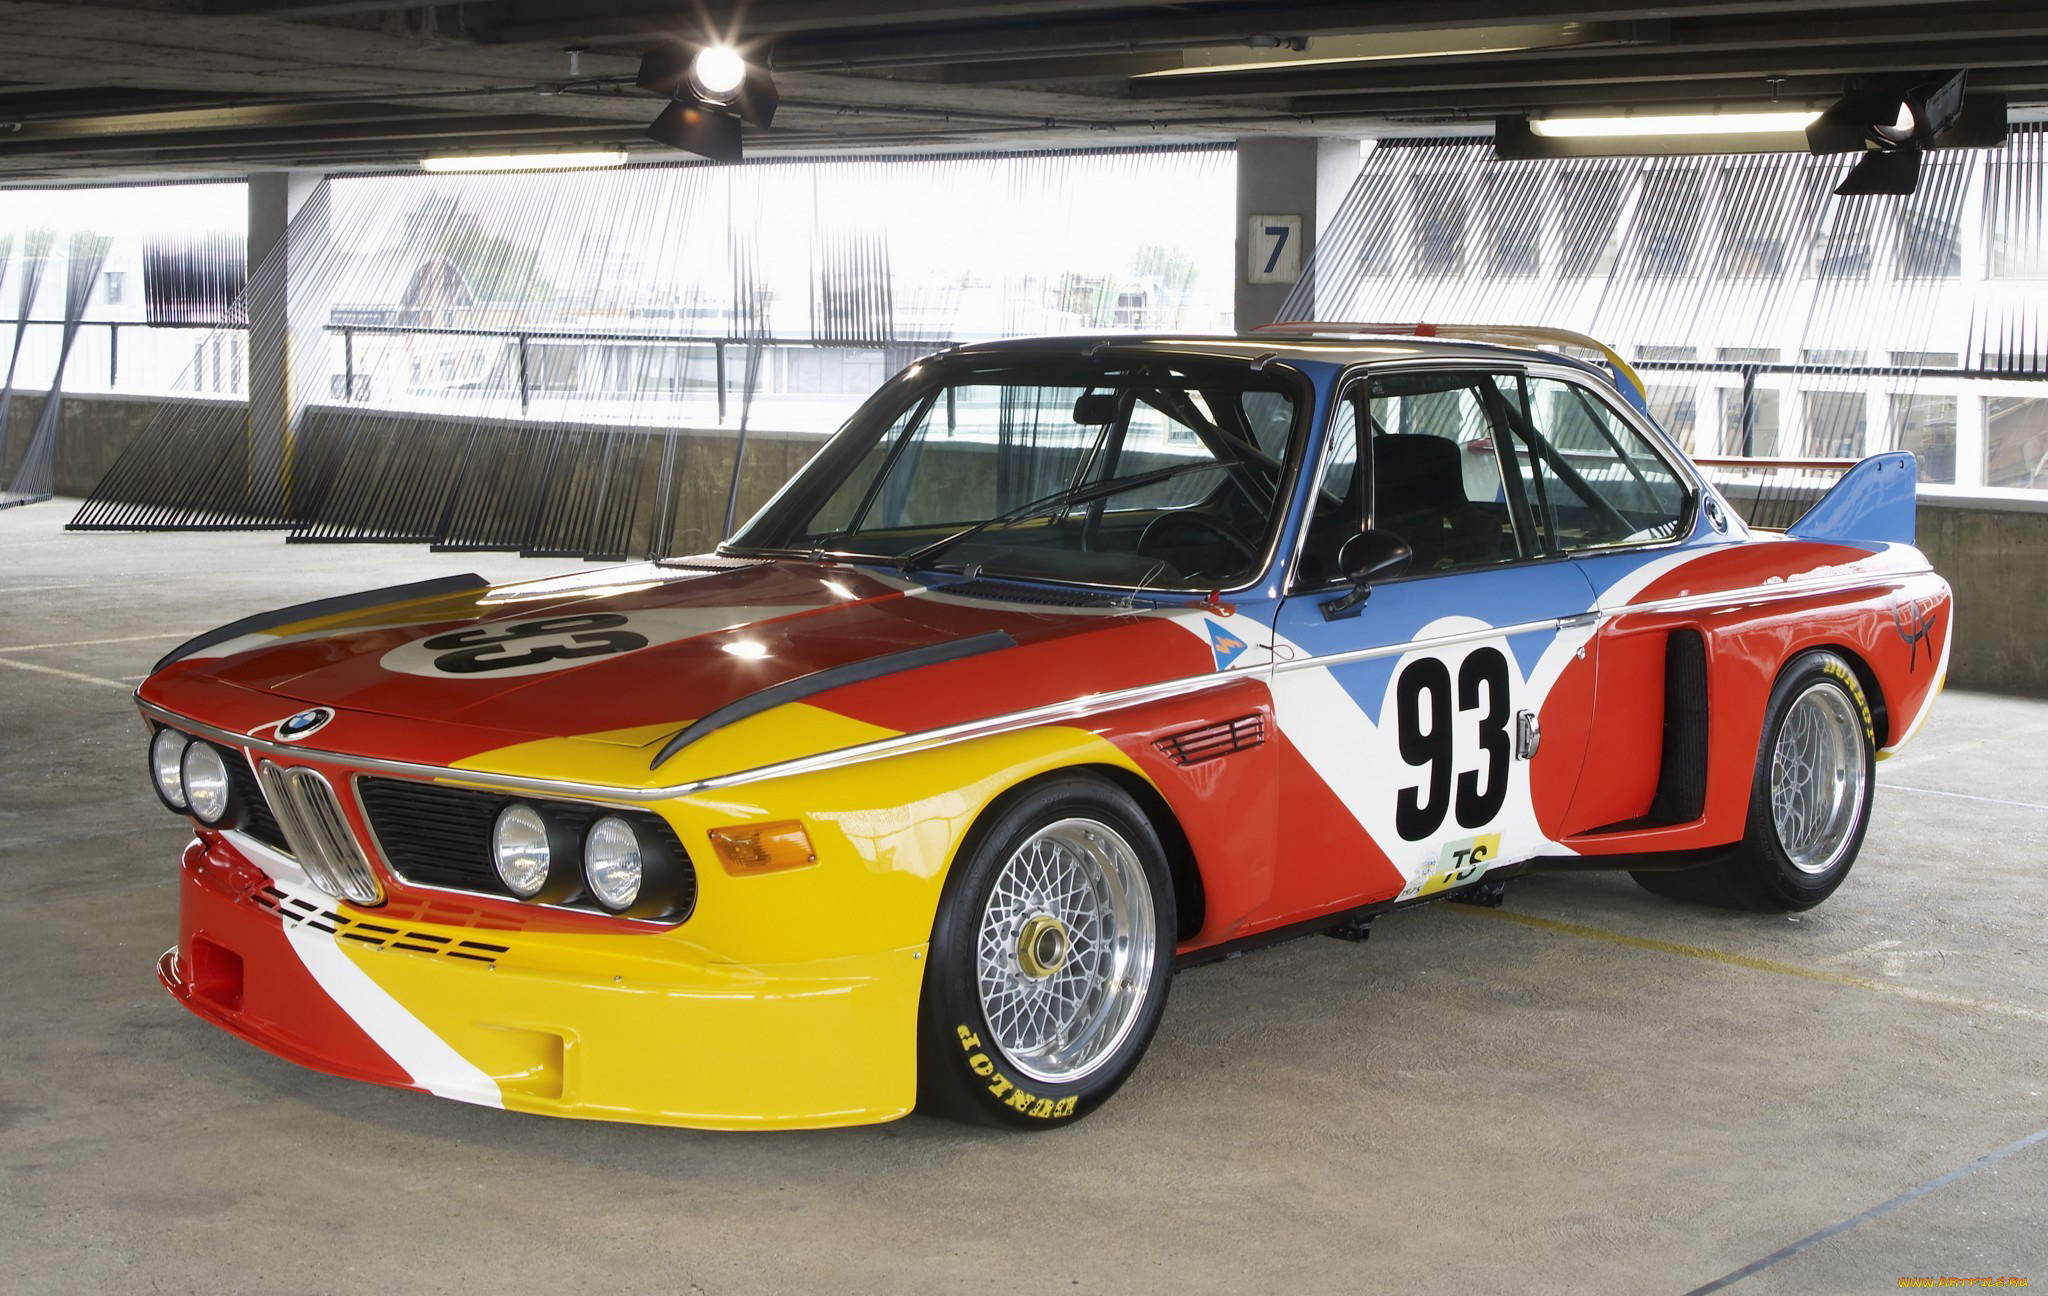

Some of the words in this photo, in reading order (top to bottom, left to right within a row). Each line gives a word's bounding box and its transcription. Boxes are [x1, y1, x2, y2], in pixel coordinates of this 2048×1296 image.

[1264, 226, 1290, 273] 7
[423, 613, 650, 674] 93
[1395, 646, 1511, 842] 93
[957, 1025, 1079, 1118] DUNLOP
